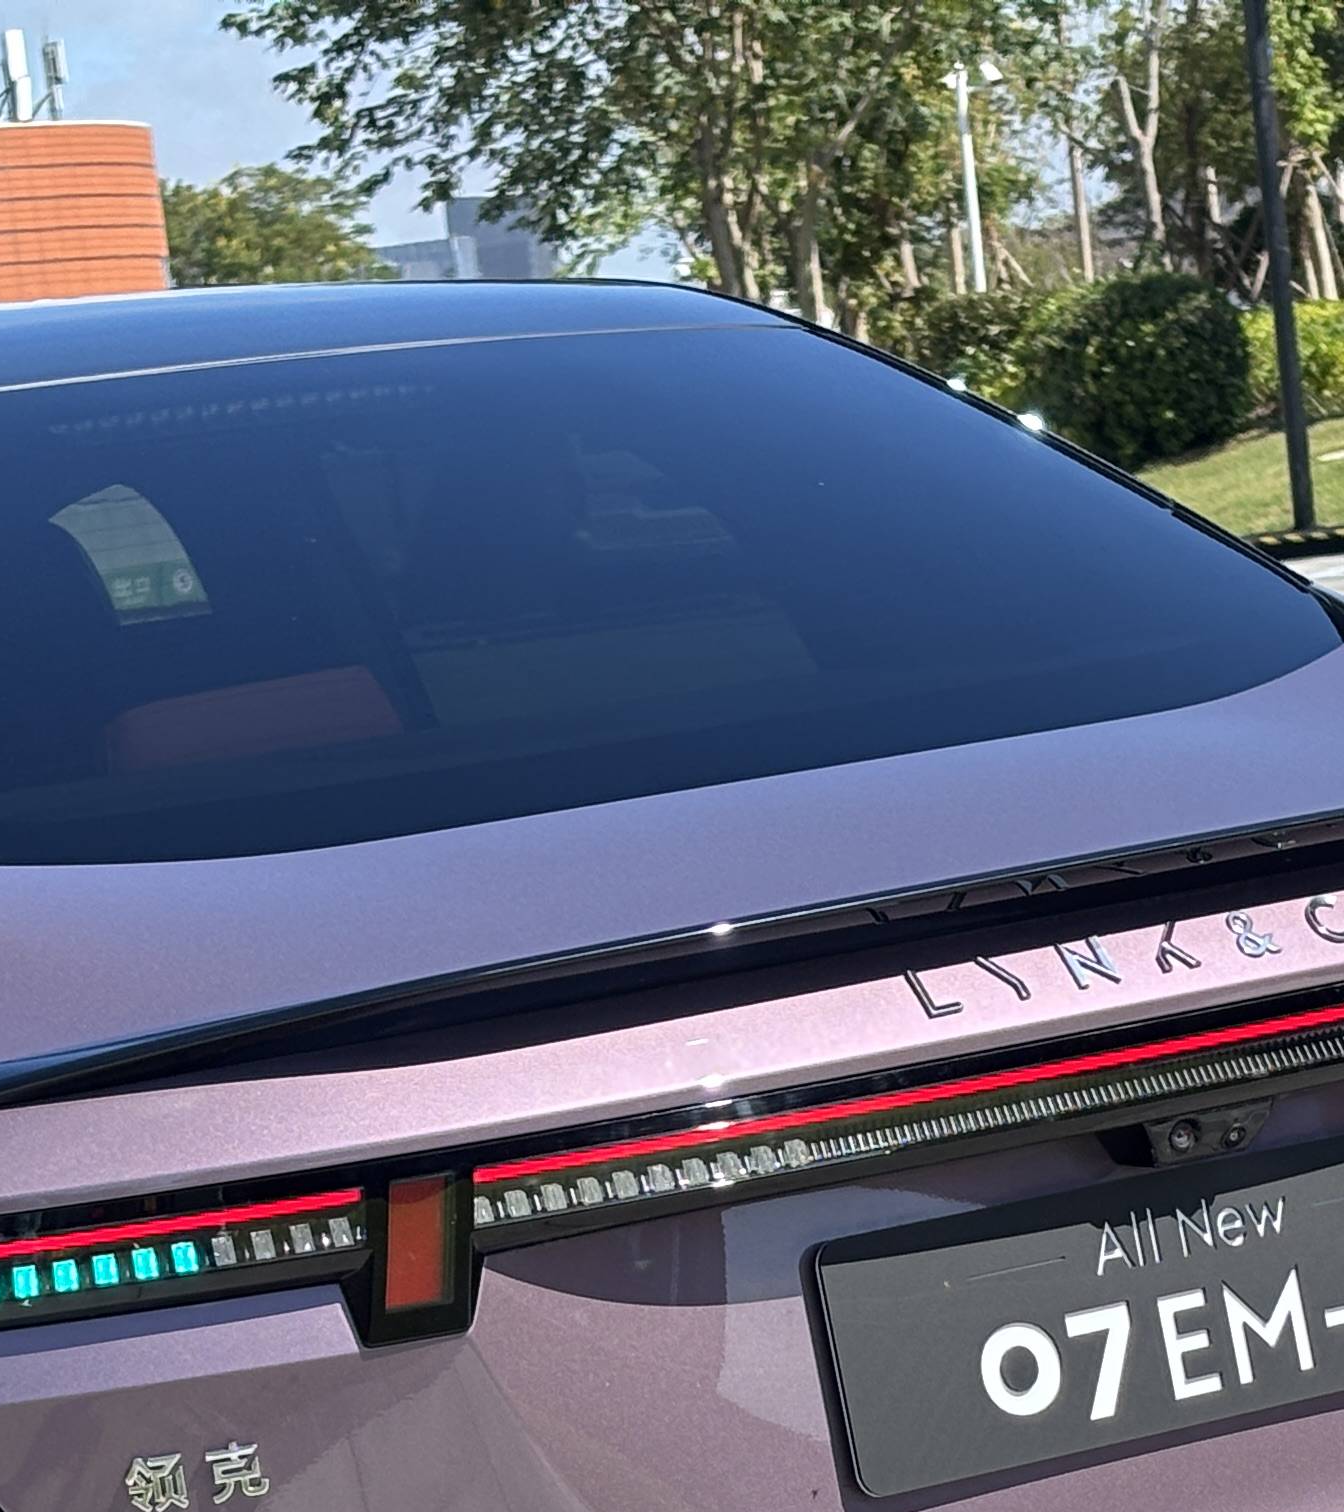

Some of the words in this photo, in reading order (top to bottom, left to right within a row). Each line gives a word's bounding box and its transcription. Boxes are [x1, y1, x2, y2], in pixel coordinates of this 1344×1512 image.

[1097, 1207, 1161, 1277] All
[1176, 1197, 1286, 1259] New
[125, 1440, 270, 1512] 领克
